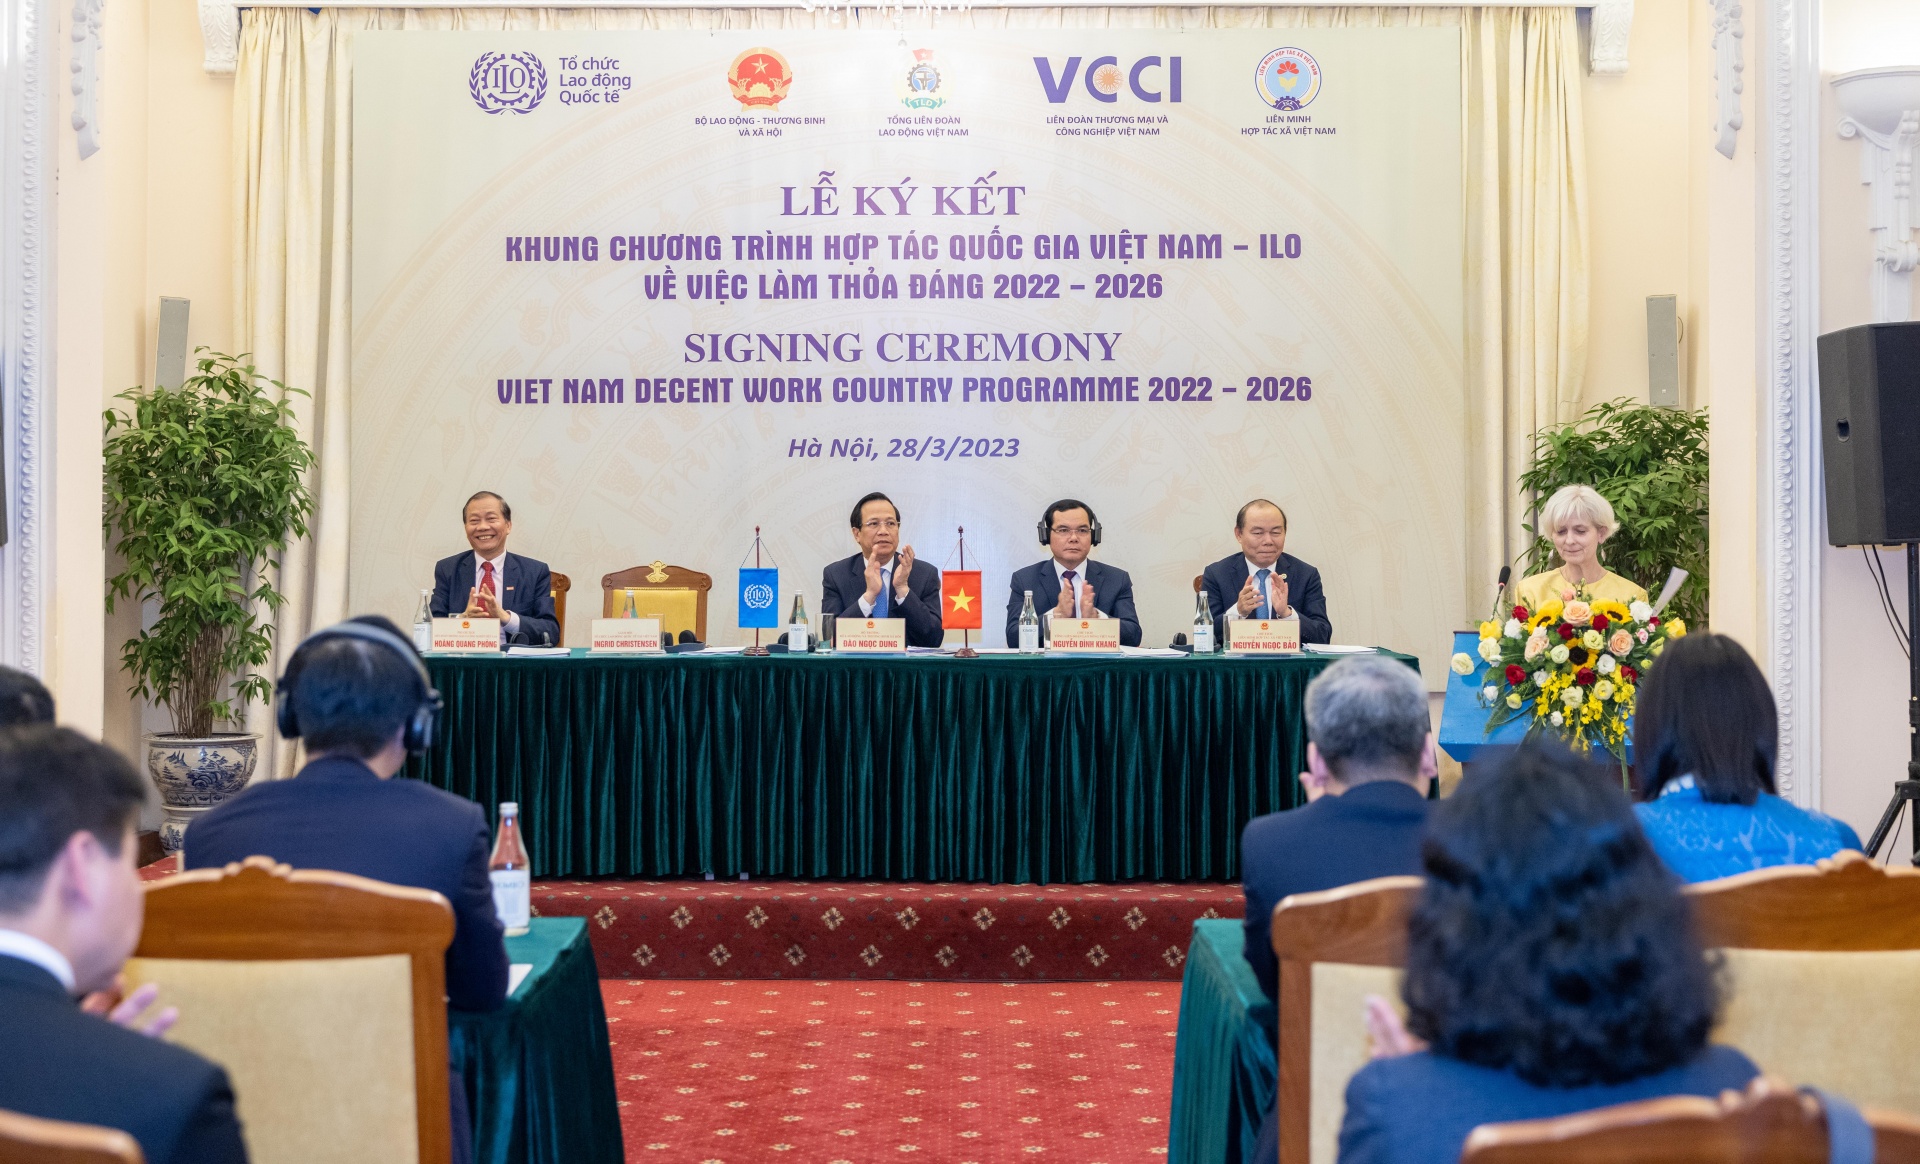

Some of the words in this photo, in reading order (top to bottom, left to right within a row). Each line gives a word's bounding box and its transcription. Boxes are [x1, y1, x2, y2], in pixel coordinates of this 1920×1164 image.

[559, 55, 578, 70] Tổ
[582, 56, 620, 70] chức
[492, 64, 526, 94] ILO
[559, 74, 587, 87] Lao
[591, 73, 632, 90] động
[1033, 56, 1182, 104] VCCI
[559, 89, 600, 106] Quốc
[605, 89, 620, 103] tế
[695, 116, 707, 126] BỘ
[709, 117, 727, 125] LAO
[729, 115, 755, 126] ĐỘNG
[763, 116, 801, 125] THƯƠNG
[804, 117, 826, 125] BINH
[887, 114, 911, 125] TỔNG
[914, 115, 932, 125] LIÊN
[935, 115, 960, 125] ĐOÀN
[1046, 114, 1065, 124] LIÊN
[1067, 114, 1092, 124] ĐOÀN
[1095, 115, 1135, 124] THƯƠNG
[1137, 116, 1155, 126] MẠI
[1157, 115, 1169, 124] VÀ
[1266, 114, 1284, 123] LIÊN
[1287, 115, 1311, 123] MINH
[739, 127, 751, 137] VÀ
[753, 127, 765, 137] XÃ
[767, 127, 782, 138] HỘI
[878, 128, 896, 137] LAO
[898, 127, 924, 138] ĐỘNG
[926, 127, 944, 138] VIỆT
[947, 128, 969, 137] NAM
[1055, 126, 1081, 136] CÔNG
[1083, 126, 1116, 138] NGHIỆP
[1118, 126, 1136, 138] VIỆT
[1139, 128, 1160, 136] NAM
[1241, 126, 1259, 137] HỢP
[1261, 126, 1278, 135] TÁC
[1279, 125, 1292, 135] XÃ
[1294, 125, 1313, 137] VIỆT
[1315, 127, 1336, 135] NAM
[780, 171, 840, 216] LỄ
[853, 177, 919, 216] KÝ
[932, 171, 1026, 216] KẾT
[505, 235, 599, 262] KHUNG
[609, 233, 722, 262] CHƯƠNG
[732, 230, 813, 261] TRÌNH
[824, 233, 879, 265] HỢP
[888, 230, 939, 260] TÁC
[949, 225, 1023, 261] QUỐC
[1033, 234, 1080, 260] GIA
[1089, 229, 1148, 265] VIỆT
[1158, 233, 1222, 260] NAM
[1259, 233, 1302, 259] ILO
[644, 265, 677, 300] VỀ
[687, 269, 748, 306] VIỆC
[758, 268, 818, 300] LÀM
[828, 266, 898, 300] THỎA
[908, 268, 984, 300] ĐÁNG
[993, 273, 1061, 299] 2022
[1095, 273, 1163, 299] 2026
[684, 332, 864, 363] SIGNING
[876, 332, 1123, 363] CEREMONY
[497, 378, 553, 405] VIET
[562, 378, 624, 404] NAM
[635, 377, 734, 404] DECENT
[742, 377, 822, 403] WORK
[832, 377, 953, 403] COUNTRY
[962, 376, 1140, 403] PROGRAMME
[1148, 376, 1213, 402] 2022
[1246, 376, 1312, 402] 2026
[788, 437, 823, 458] Hà
[829, 437, 879, 462] Nội,
[886, 437, 1020, 462] 28/3/2023
[456, 640, 476, 648] QUANG
[594, 640, 615, 648] INGRID
[616, 640, 658, 648] CHRISTENSEN
[858, 640, 877, 650] NGỌC
[879, 640, 898, 648] DUNG
[1096, 640, 1117, 648] KHANG
[1262, 641, 1281, 650] NGỌC
